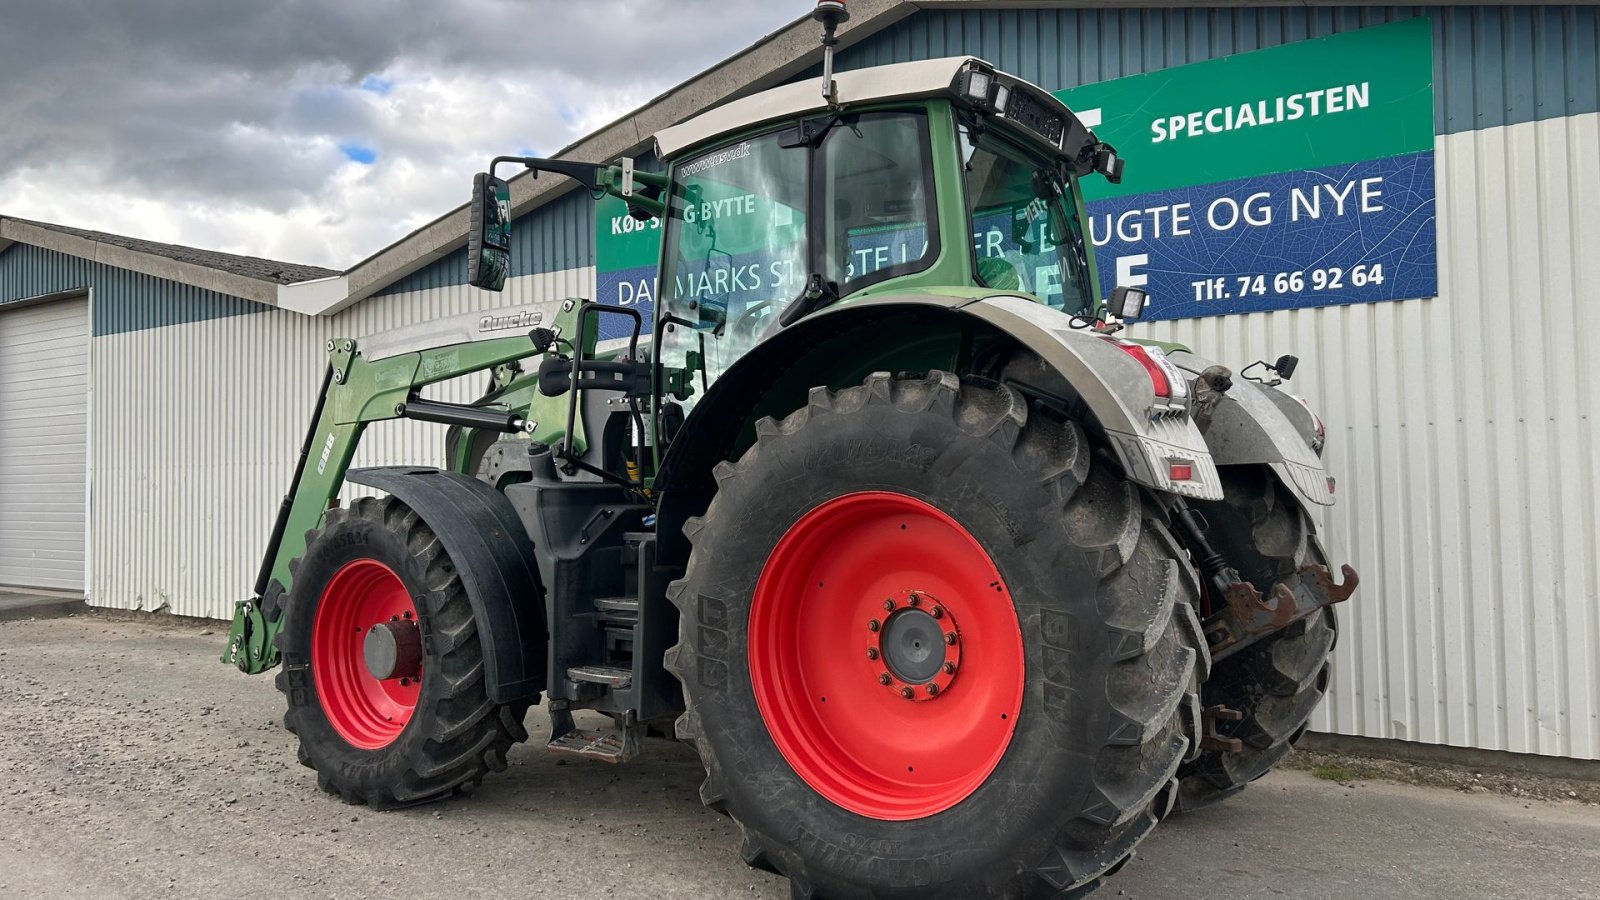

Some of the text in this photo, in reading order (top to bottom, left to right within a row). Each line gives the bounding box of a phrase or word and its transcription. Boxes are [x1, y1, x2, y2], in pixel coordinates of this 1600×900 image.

[1151, 82, 1369, 143] SPECIALISTEN
[618, 263, 761, 305] DAMARKS
[1040, 203, 1191, 254] BUGTE
[1207, 192, 1272, 231] OG
[1291, 177, 1384, 222] NYE
[1192, 264, 1384, 301] Tlf. 74 66 92 64
[479, 311, 542, 332] Quicke
